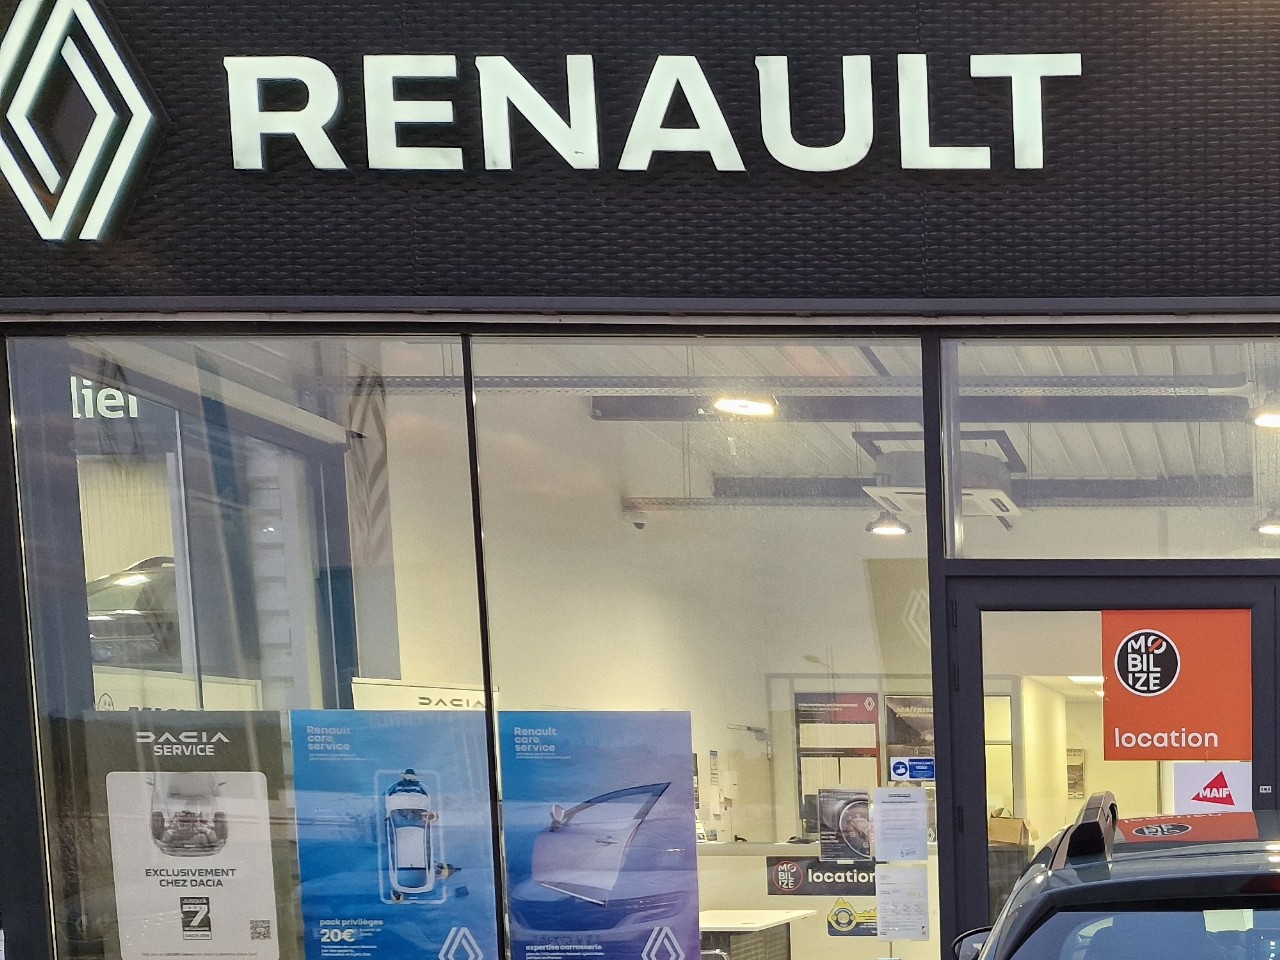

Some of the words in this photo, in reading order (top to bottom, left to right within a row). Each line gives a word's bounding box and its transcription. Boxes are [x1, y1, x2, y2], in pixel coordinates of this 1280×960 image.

[223, 53, 1082, 173] RENAULT
[417, 696, 486, 708] DACIA
[307, 725, 351, 735] Renault
[514, 727, 557, 736] Renault
[136, 731, 230, 743] DACIA
[514, 736, 540, 744] care
[1114, 728, 1219, 748] location
[153, 744, 215, 756] SERVICE
[308, 742, 351, 751] service
[515, 743, 556, 752] service
[1200, 787, 1231, 798] MAIF
[145, 869, 237, 877] EXCLUSIVEMENT
[159, 879, 187, 887] CHEZ
[190, 879, 224, 887] DACIA
[320, 918, 340, 927] pack
[525, 944, 560, 952] expertise
